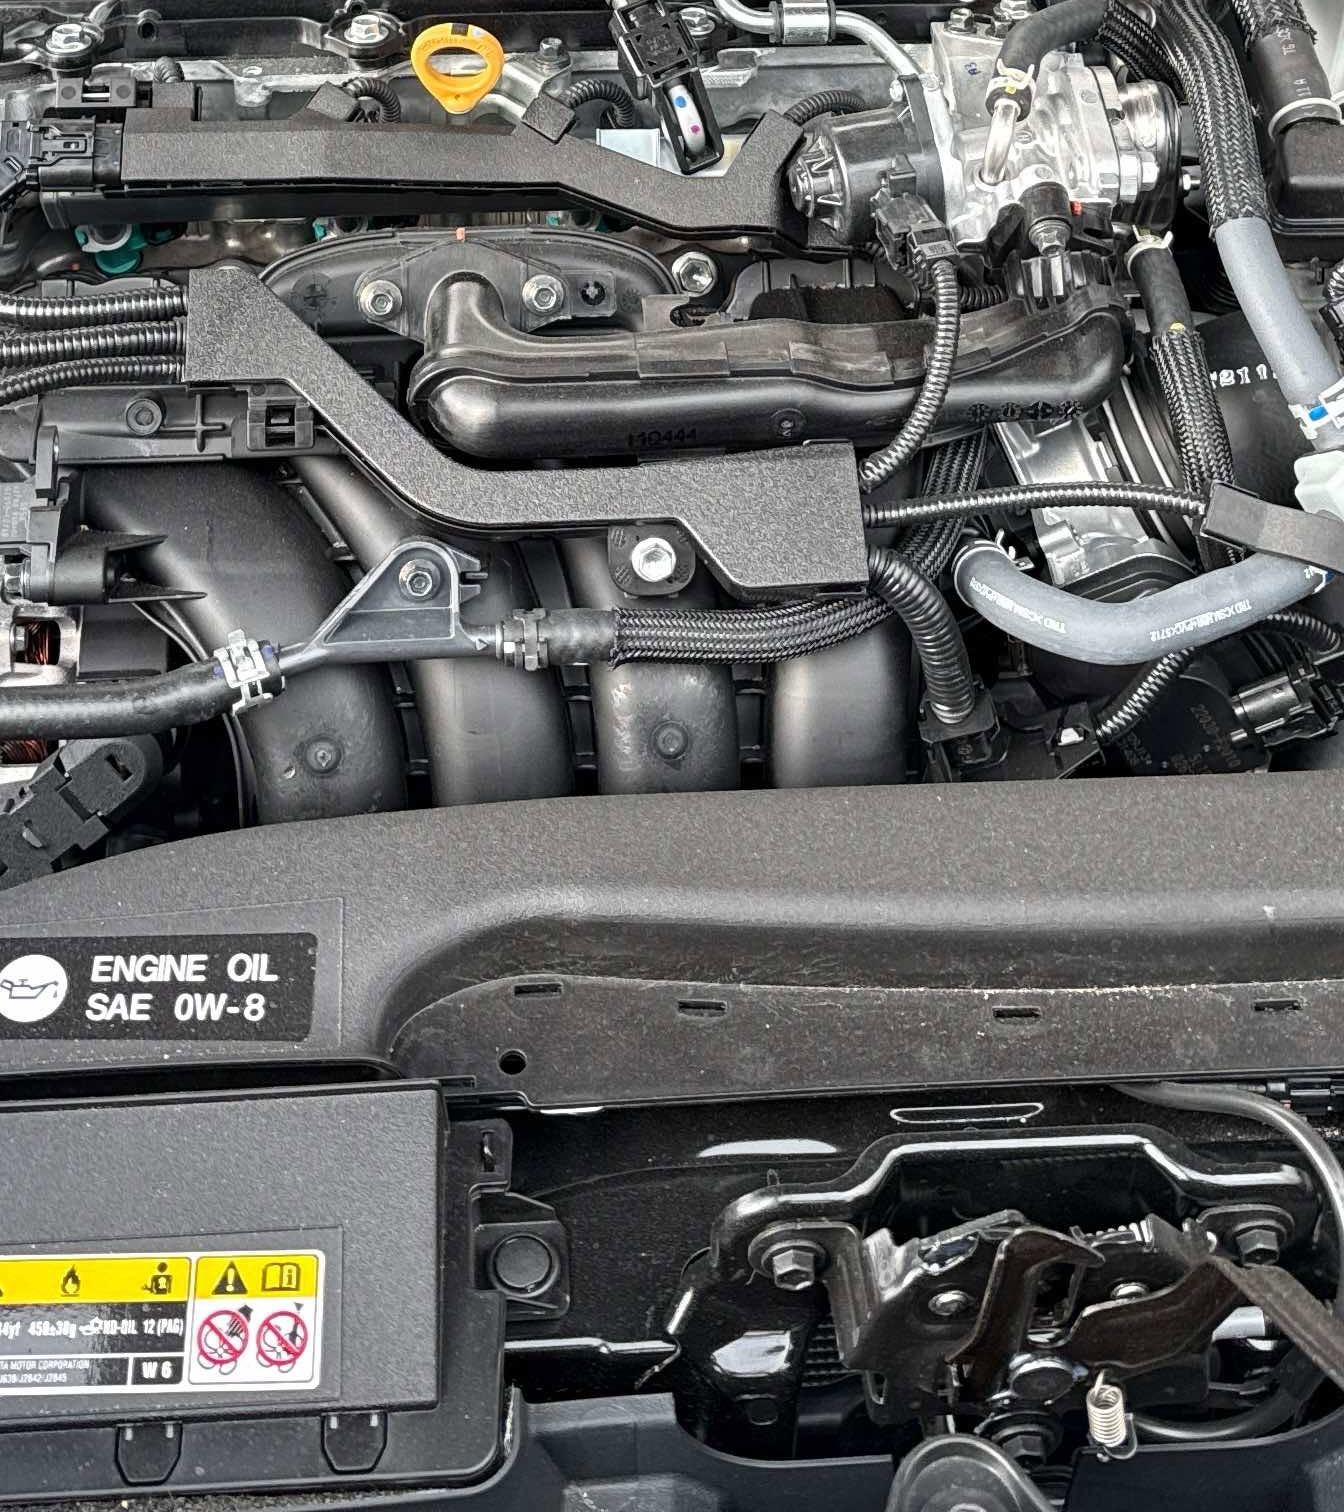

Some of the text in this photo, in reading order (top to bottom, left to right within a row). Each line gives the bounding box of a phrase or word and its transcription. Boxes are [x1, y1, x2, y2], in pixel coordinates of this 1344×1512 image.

[91, 952, 278, 982] ENGINE OIL
[85, 992, 265, 1021] SAE 0W-8
[143, 1319, 155, 1335] 12
[157, 1318, 184, 1336] (PAG)
[10, 1360, 36, 1370] MOTOR
[38, 1359, 90, 1370] CORPORATION
[142, 1361, 172, 1379] W 6
